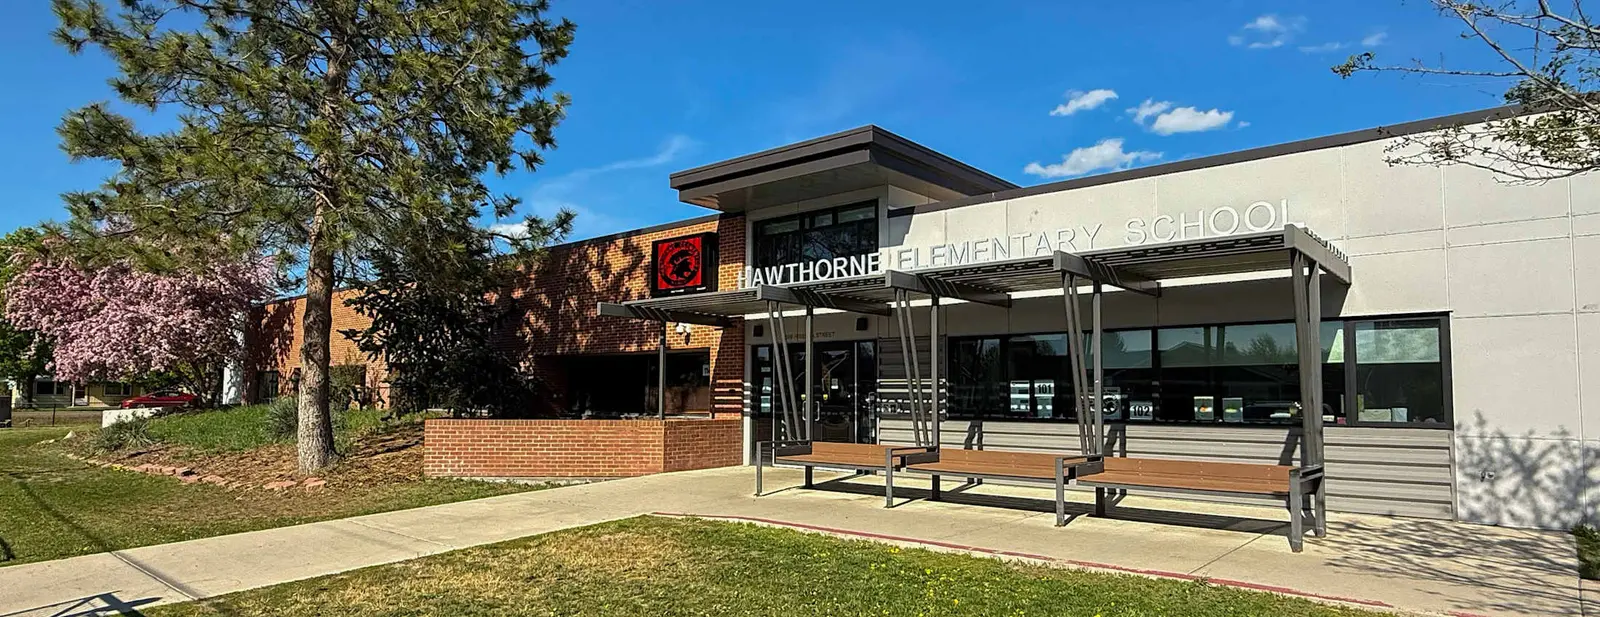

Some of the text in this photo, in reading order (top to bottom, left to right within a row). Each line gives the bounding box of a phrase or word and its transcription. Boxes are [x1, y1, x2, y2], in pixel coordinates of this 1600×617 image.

[738, 251, 882, 288] HAWTHORNE
[898, 222, 1103, 270] ELEMENTARY
[1124, 199, 1305, 245] SCHOOL
[1037, 384, 1051, 394] 101
[1133, 405, 1150, 416] 102
